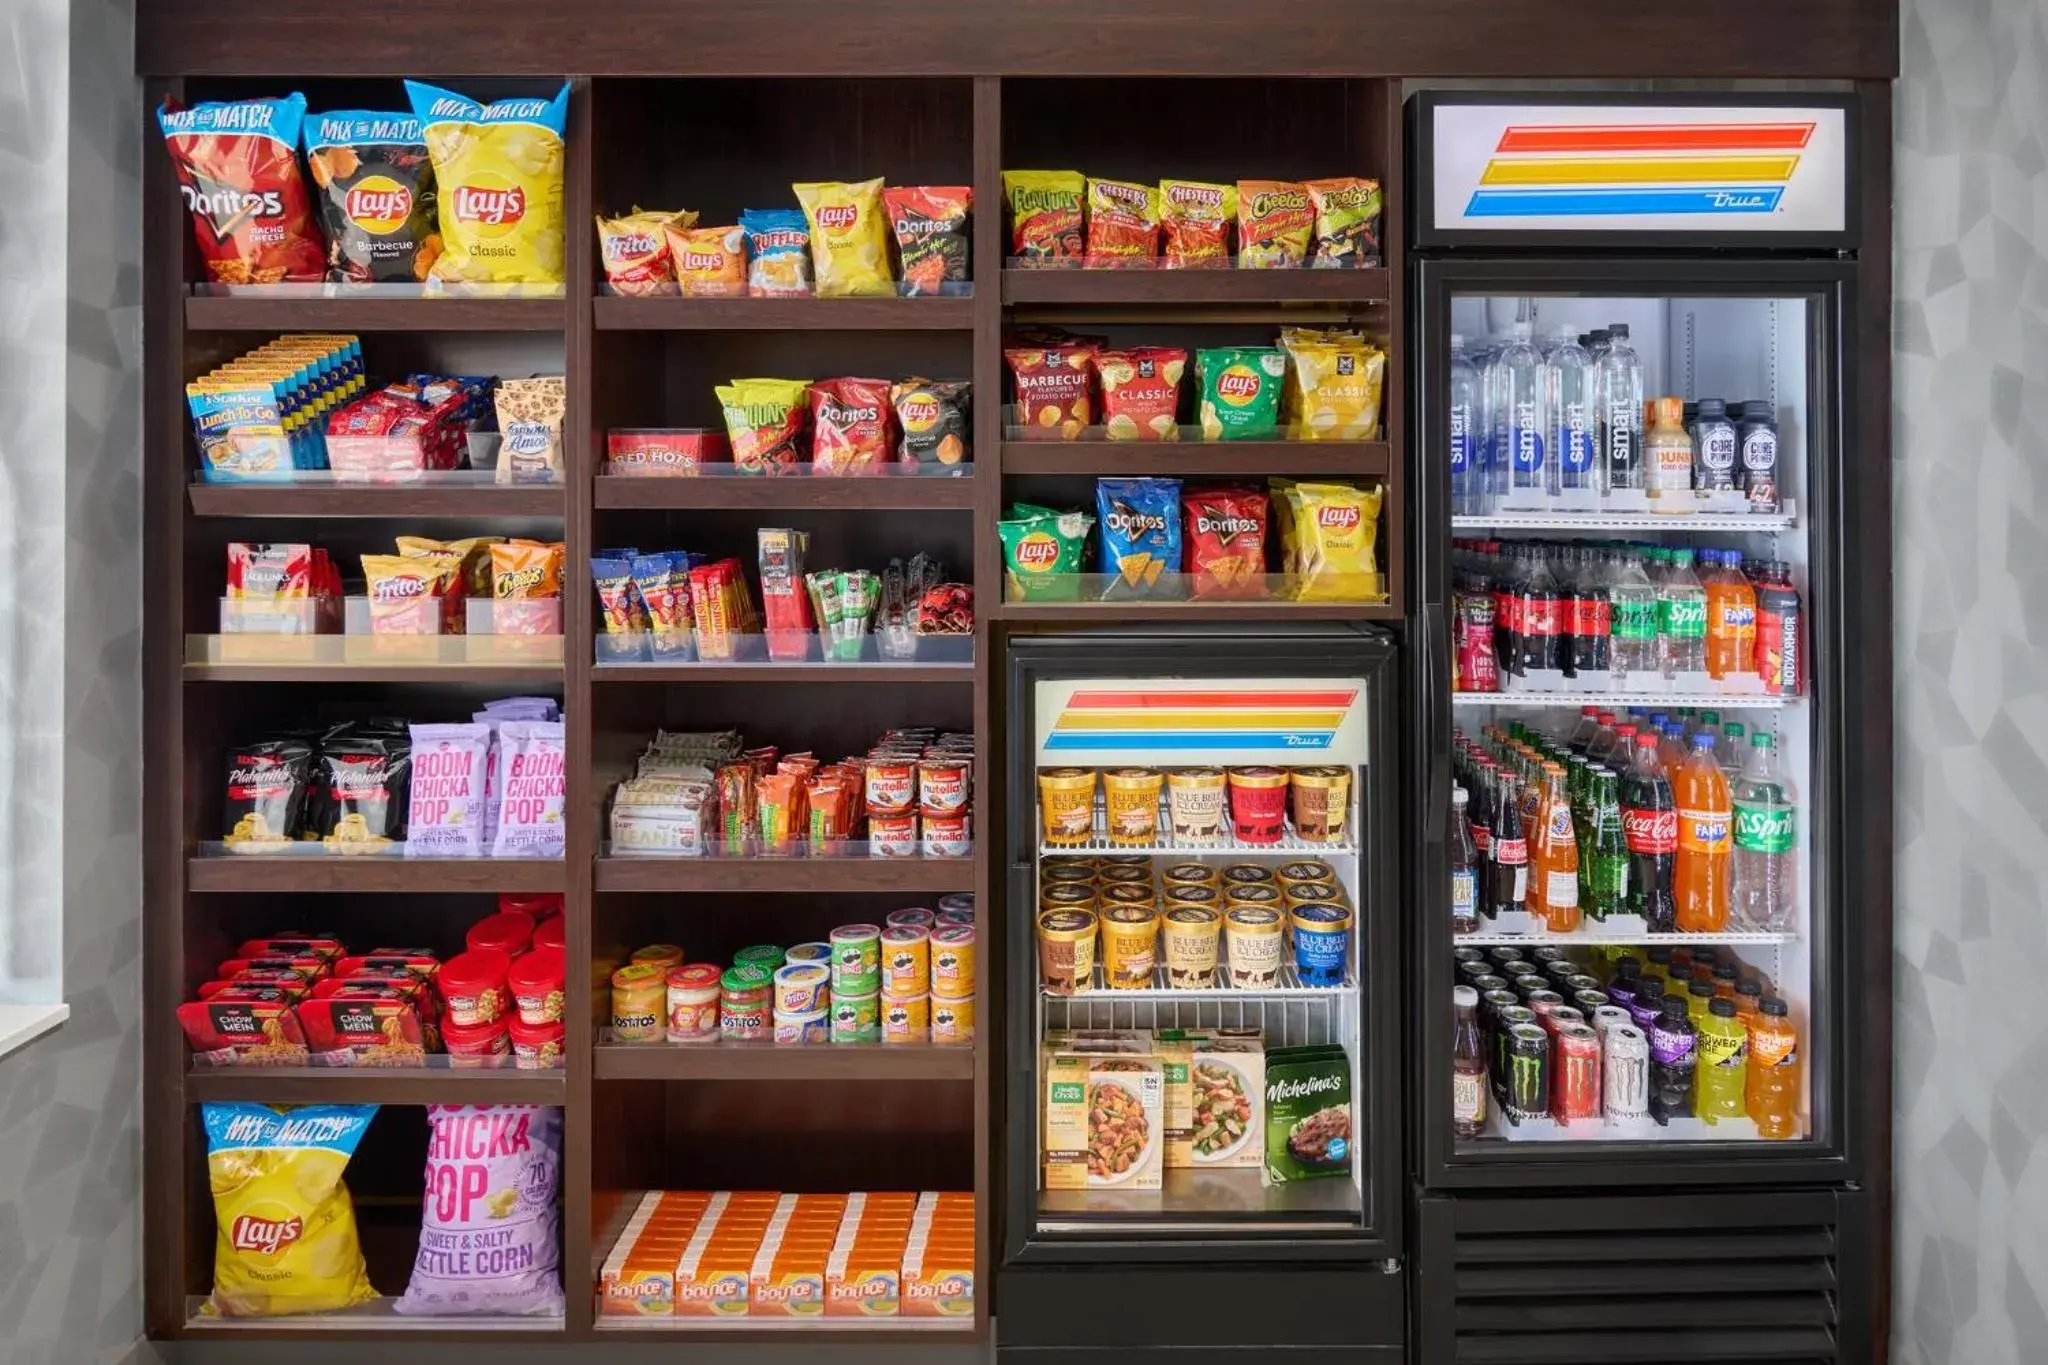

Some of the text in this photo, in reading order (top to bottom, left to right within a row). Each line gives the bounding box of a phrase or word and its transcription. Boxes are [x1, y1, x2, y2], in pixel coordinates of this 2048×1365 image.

[213, 104, 273, 128] MATCH
[431, 98, 471, 117] MIX
[481, 102, 544, 120] MATCH
[320, 119, 354, 140] MIX
[352, 186, 408, 220] Lay's
[454, 186, 521, 225] Lay's
[1252, 194, 1307, 217] Cheetos
[897, 220, 951, 233] Doritos
[356, 241, 413, 252] Barbecue
[469, 245, 516, 257] Classic
[752, 232, 808, 251] RUFFLES
[1022, 374, 1088, 388] BARBECUE
[1220, 374, 1258, 394] Lay's
[1120, 389, 1174, 400] CLASSIC
[1318, 387, 1372, 397] CLASSIC
[200, 408, 236, 430] Lunch
[818, 406, 877, 421] Doritos
[1451, 404, 1463, 464] smart
[1518, 401, 1535, 463] smart
[1568, 402, 1584, 463] smart
[1610, 399, 1628, 460] smart
[504, 435, 548, 450] Amos
[1711, 440, 1733, 452] CORE
[1751, 442, 1773, 454] CORE
[615, 452, 694, 467] RED HOTS
[1107, 513, 1164, 529] Doritos
[1198, 517, 1258, 532] Doritos
[1322, 507, 1358, 527] Lay's
[1019, 541, 1058, 563] Lay's
[374, 576, 426, 602] Fritos
[1784, 615, 1796, 685] BODYARMOR
[415, 752, 472, 777] BOOM
[413, 778, 469, 798] CHICKA
[507, 778, 566, 798] CHICKA
[872, 782, 909, 792] nutella
[924, 784, 960, 794] nutella
[412, 800, 449, 825] POP
[504, 800, 544, 824] POP
[1552, 811, 1571, 835] Fanta
[444, 836, 467, 844] CORN
[539, 836, 563, 845] CORN
[219, 1016, 252, 1024] CHOW
[223, 1023, 254, 1031] MEIN
[340, 1015, 373, 1023] CHOW
[344, 1022, 374, 1031] MEIN
[1654, 1028, 1692, 1045] POWER
[1700, 1032, 1737, 1048] POWER
[1266, 1075, 1341, 1103] Michelina's
[225, 1115, 345, 1142] MIX MATCH
[530, 1162, 546, 1185] 70
[424, 1164, 489, 1222] POP
[236, 1217, 299, 1254] Lay's
[427, 1230, 514, 1250] SWEET & SALTY
[476, 1243, 533, 1274] CORN
[248, 1270, 293, 1281] Classic
[609, 1283, 662, 1299] bounce
[682, 1282, 737, 1299] bounce
[757, 1283, 811, 1300] bounce
[831, 1280, 886, 1298] bounce
[908, 1279, 961, 1298] bounce
